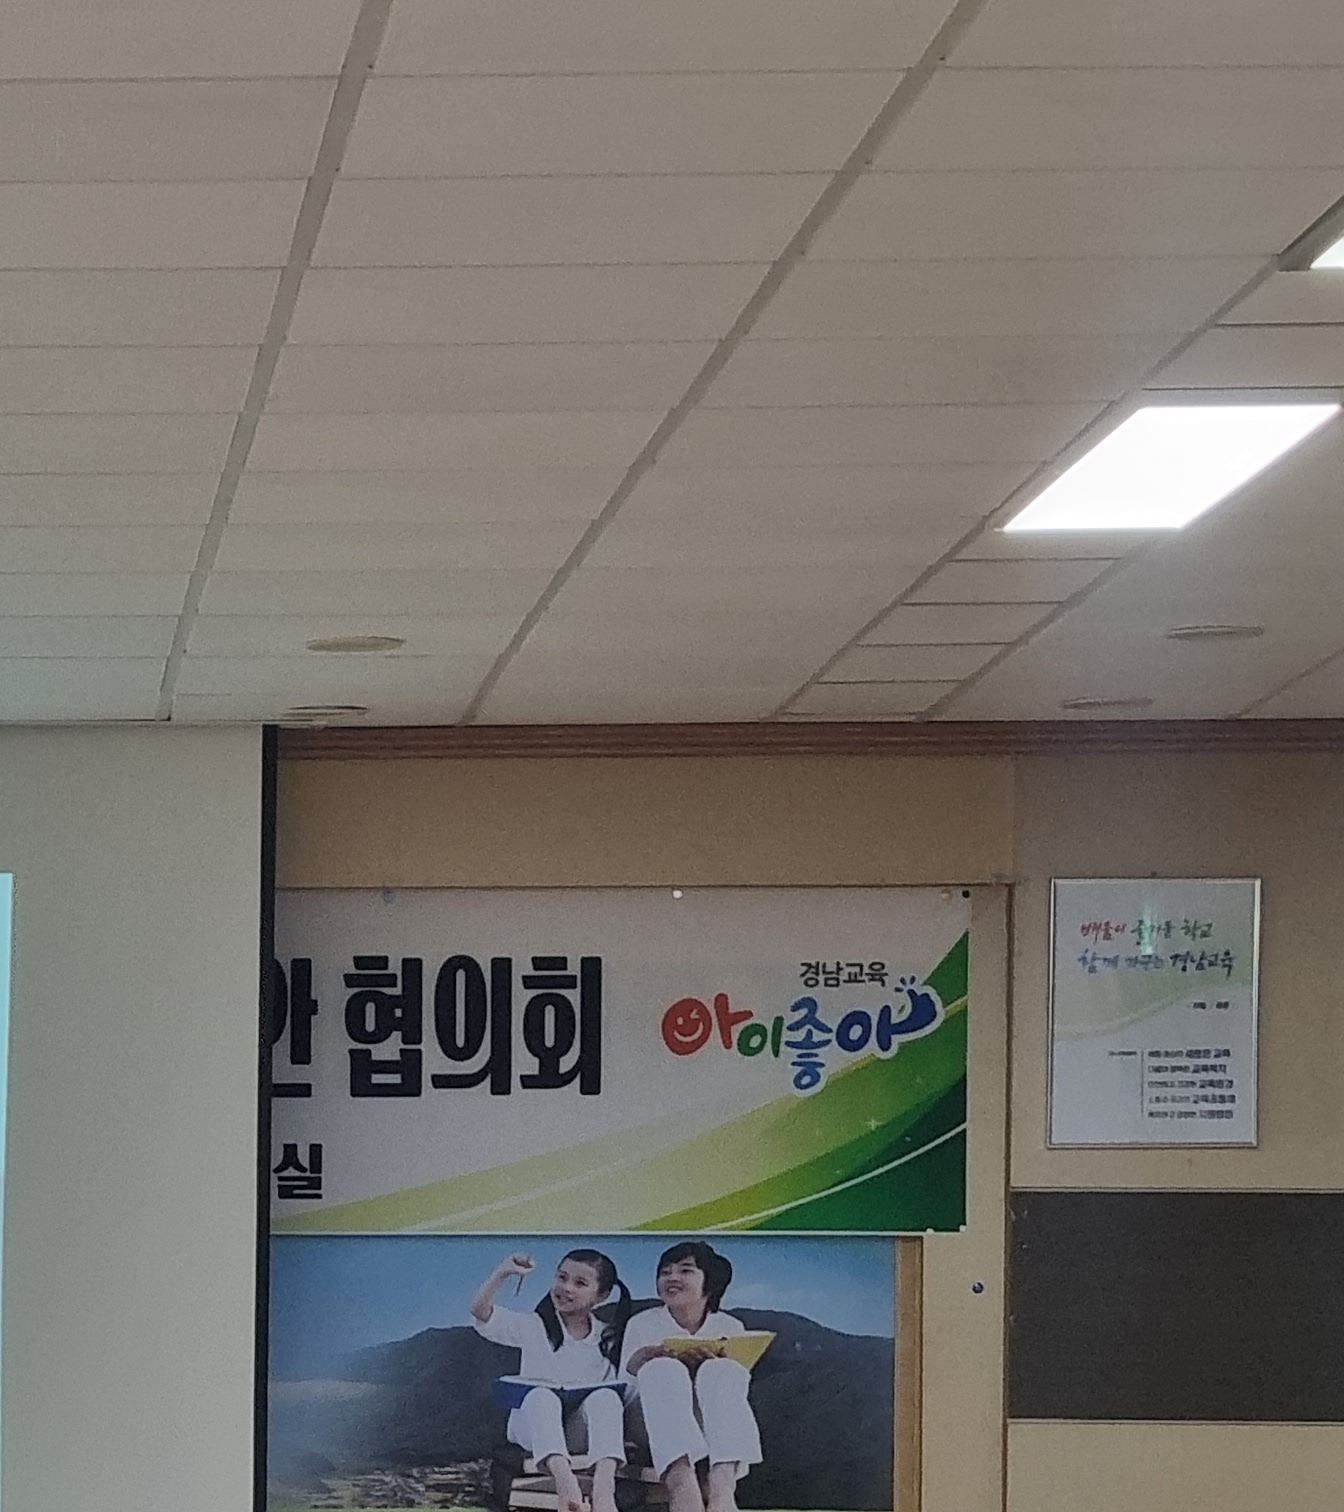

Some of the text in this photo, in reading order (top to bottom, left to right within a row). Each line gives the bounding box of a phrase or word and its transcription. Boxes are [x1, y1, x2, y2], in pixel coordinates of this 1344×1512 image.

[799, 961, 889, 988] 경남교육
[343, 955, 603, 1098] 협의회
[662, 986, 938, 1091] 아이좋아
[272, 1142, 323, 1200] 실
